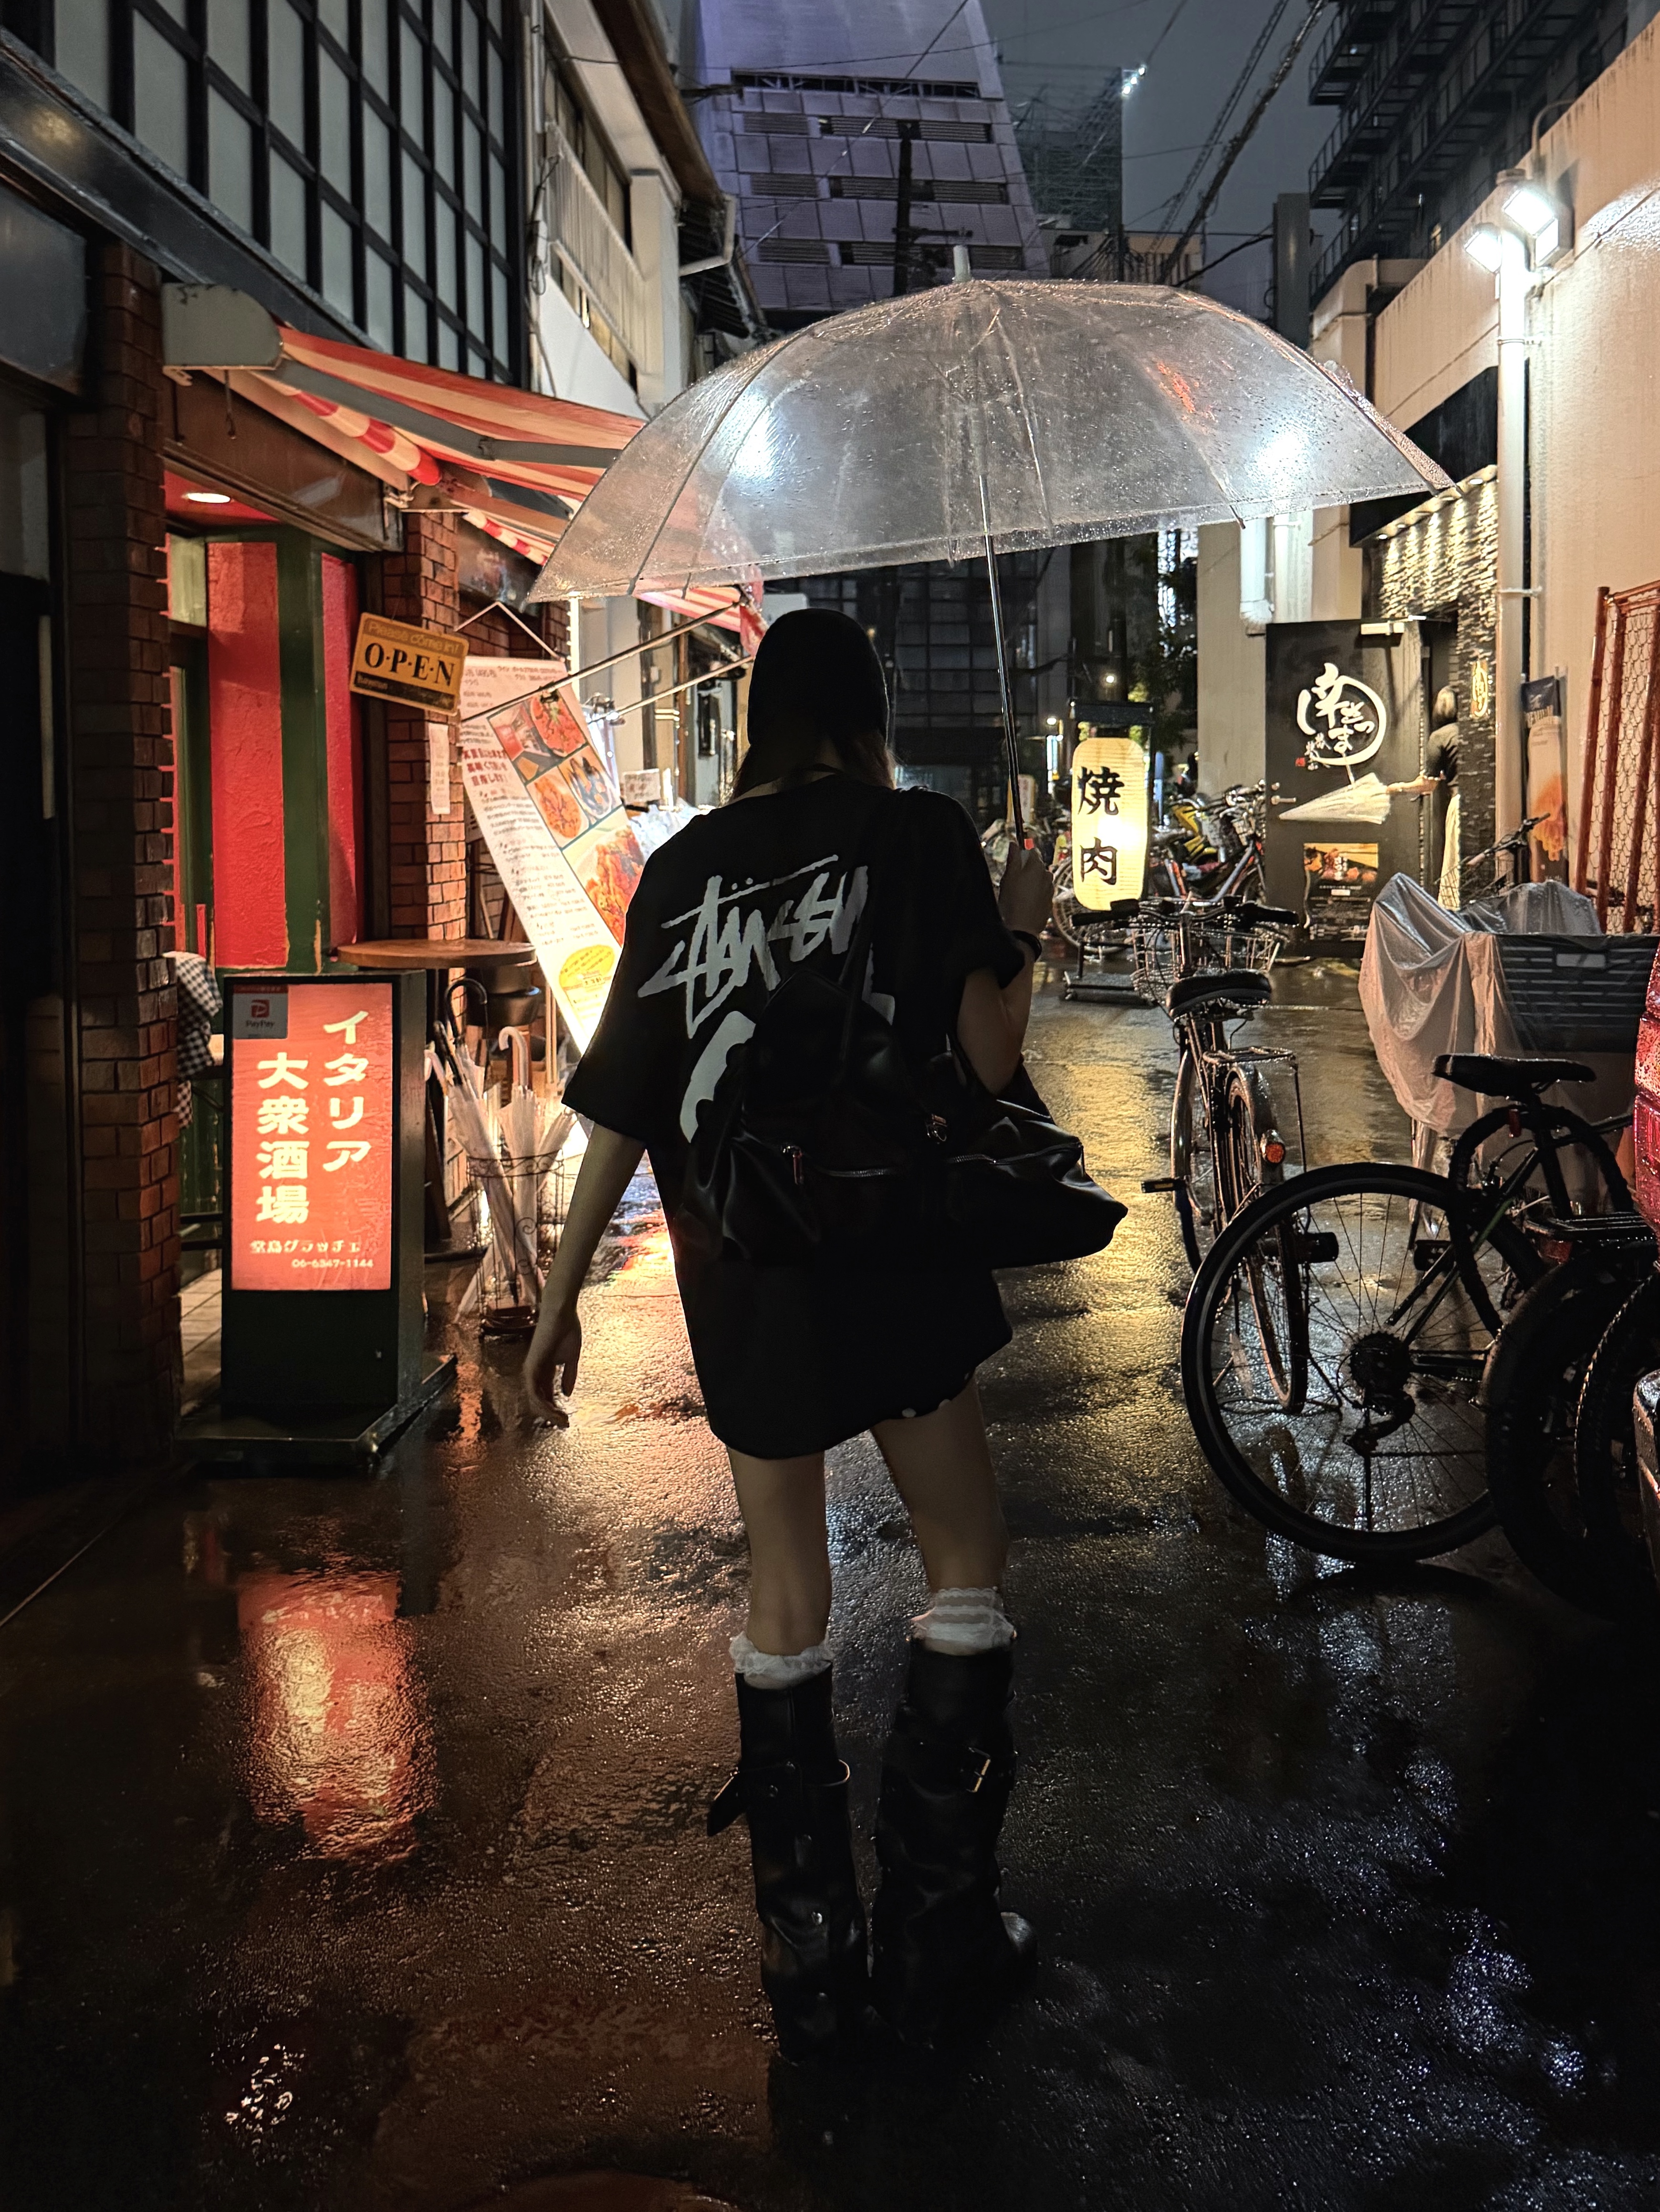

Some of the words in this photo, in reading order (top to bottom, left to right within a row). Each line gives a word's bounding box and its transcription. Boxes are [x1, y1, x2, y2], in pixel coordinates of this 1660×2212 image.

[1076, 766, 1125, 885] 焼肉
[256, 1052, 310, 1224] 大衆酒場
[323, 1010, 372, 1172] イタリア
